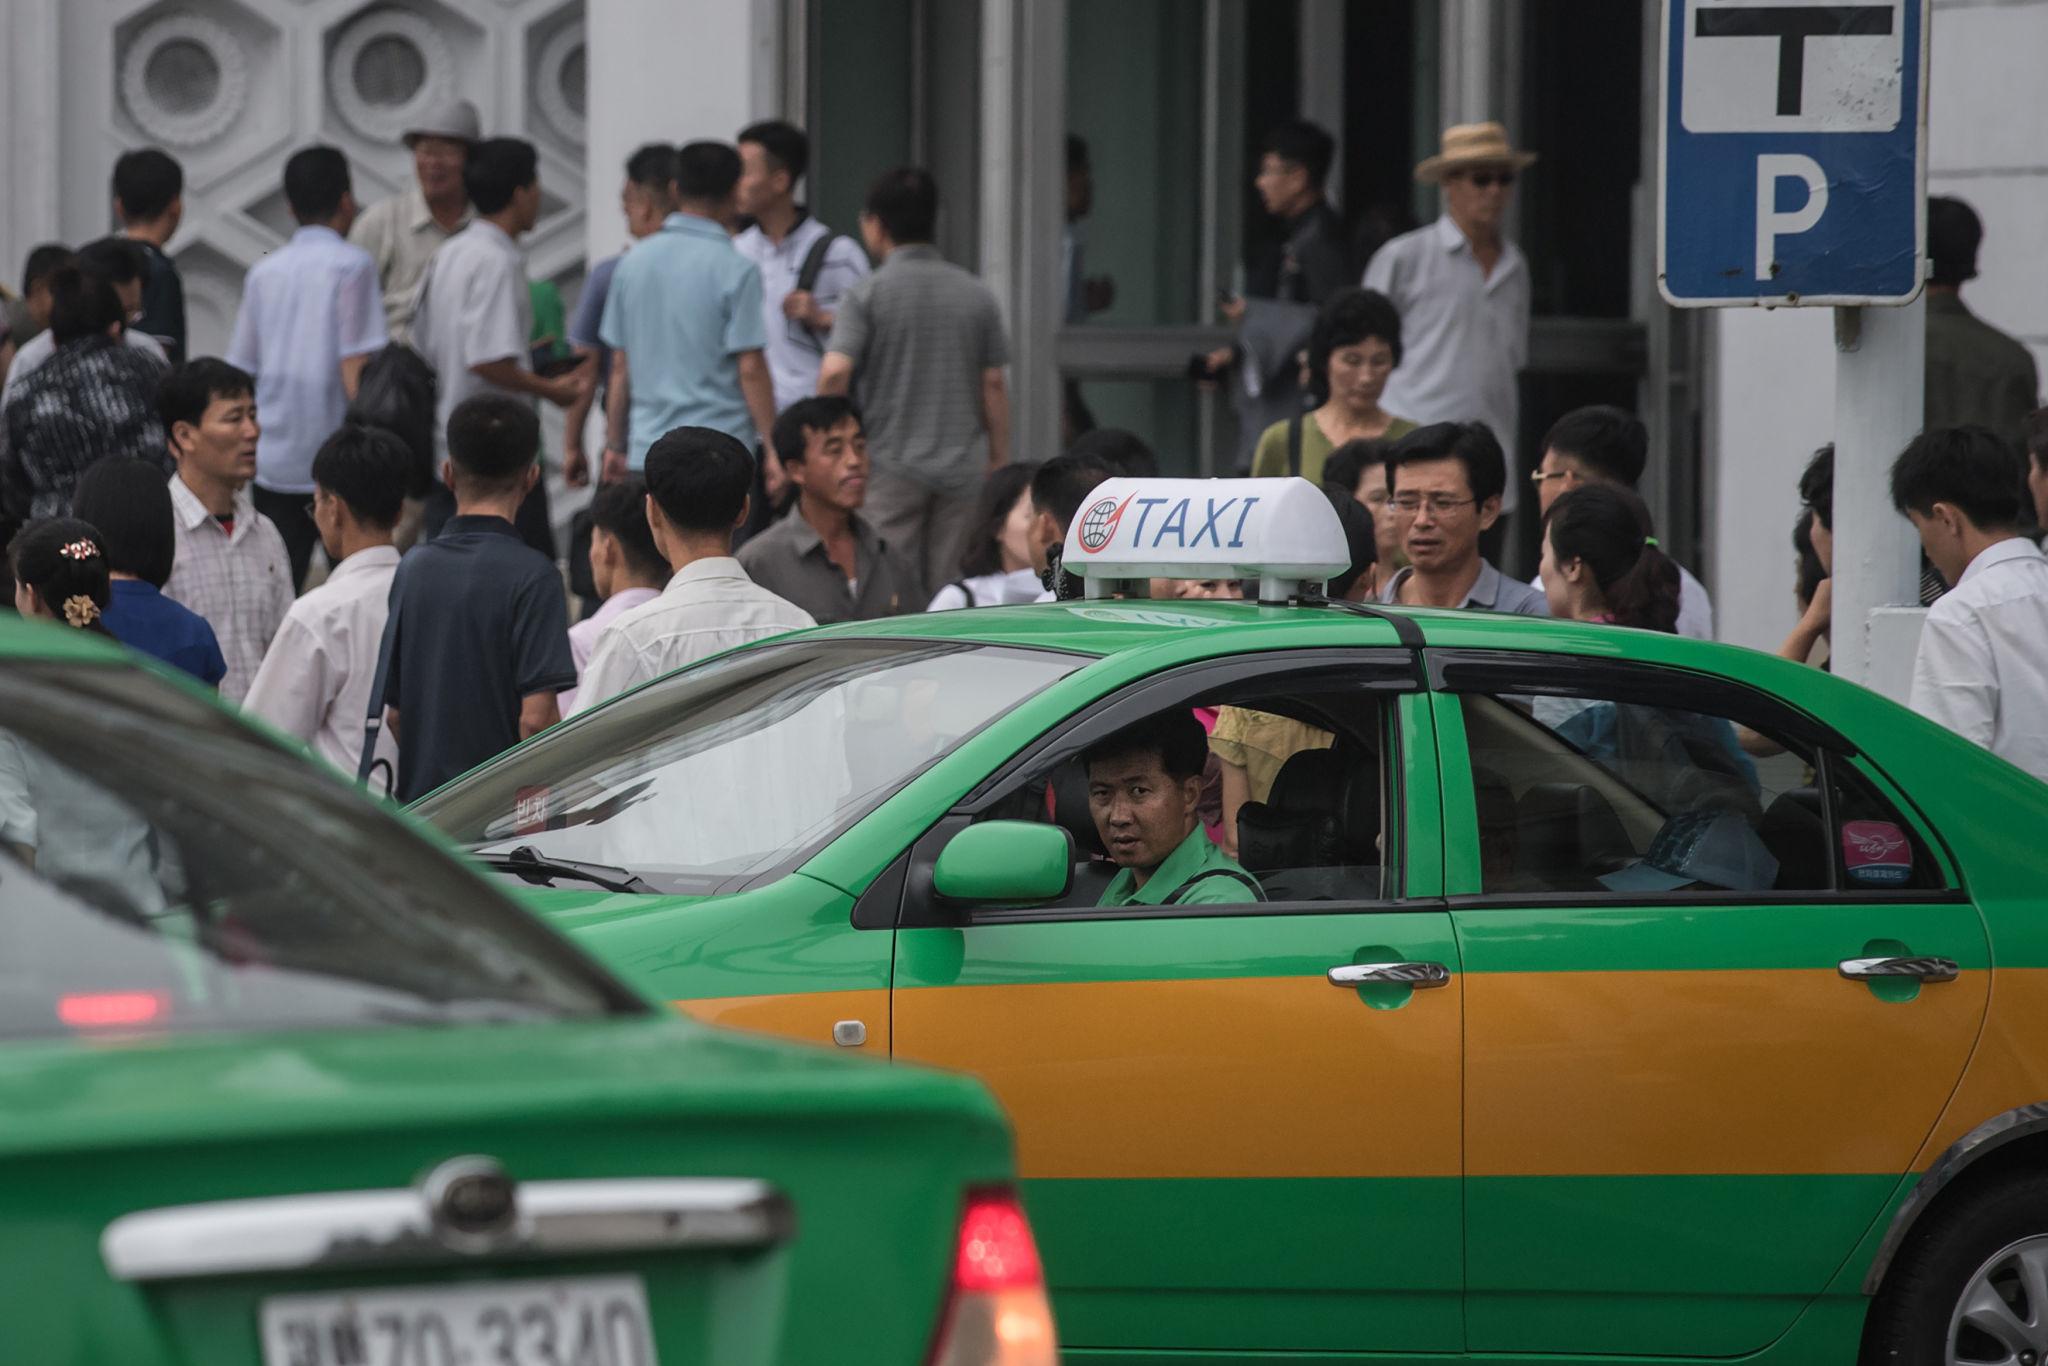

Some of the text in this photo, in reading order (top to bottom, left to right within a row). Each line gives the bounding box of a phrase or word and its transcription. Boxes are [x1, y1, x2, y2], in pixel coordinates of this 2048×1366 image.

[1755, 153, 1829, 281] P
[1131, 496, 1261, 549] TAXI
[517, 797, 546, 825] 빈차
